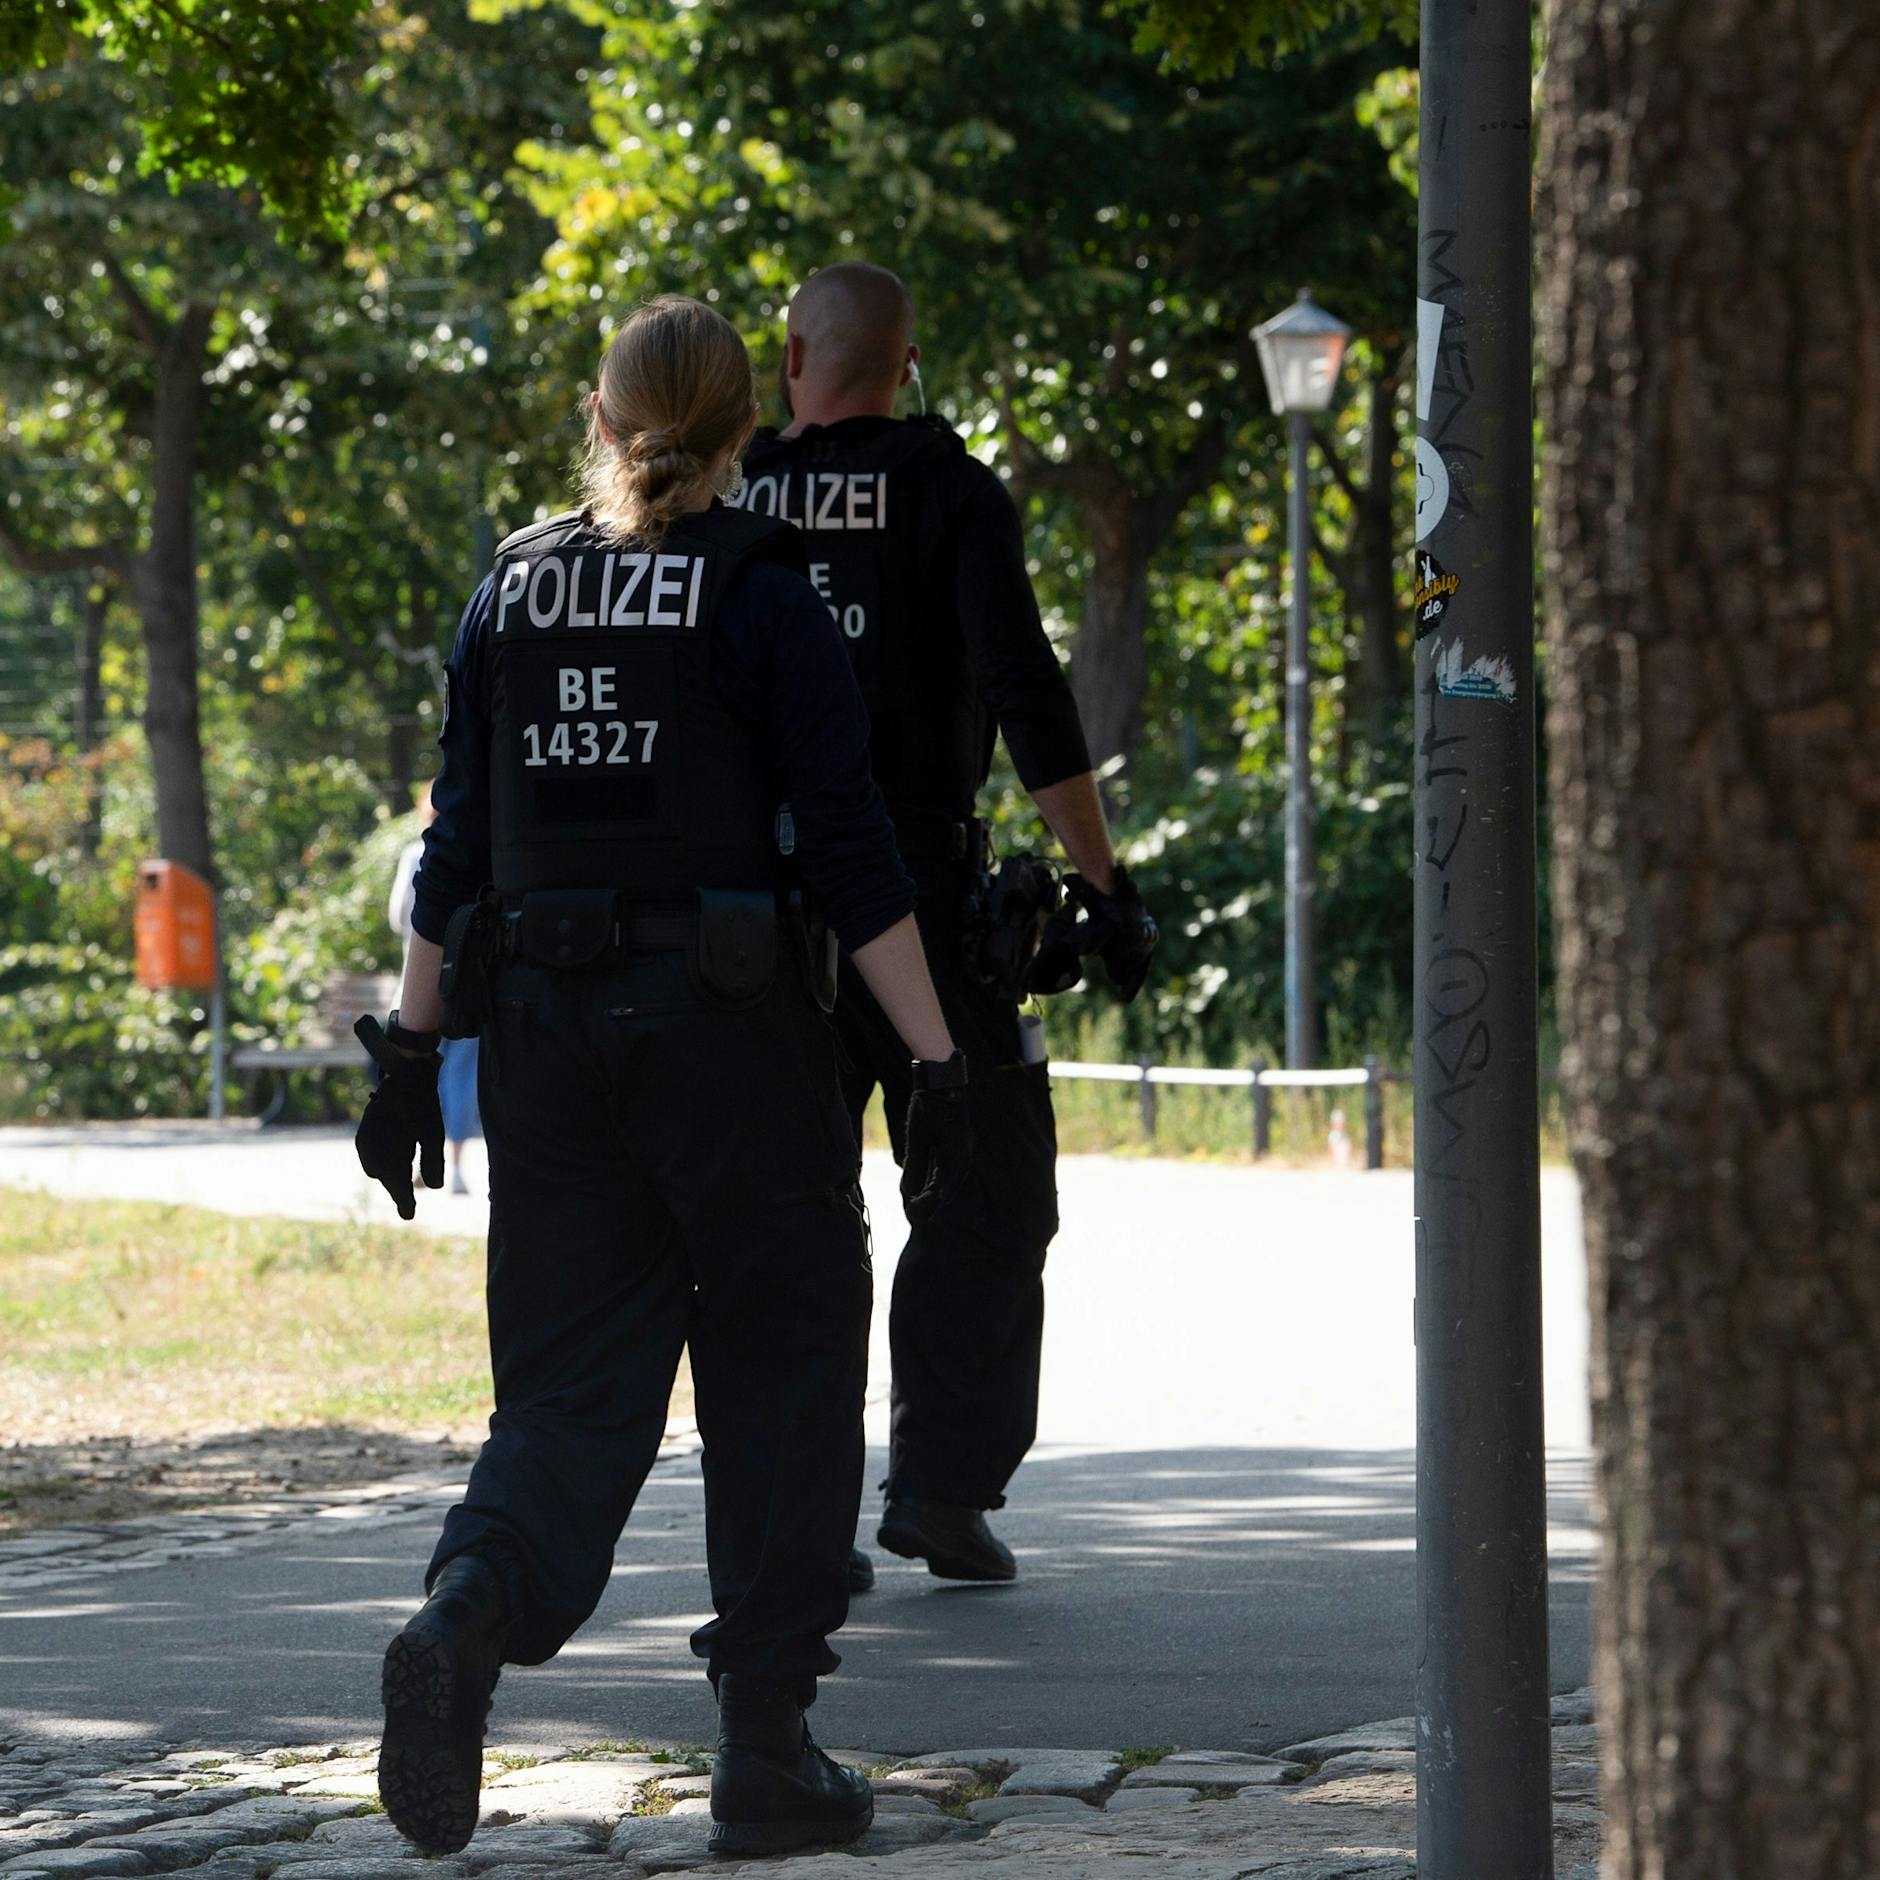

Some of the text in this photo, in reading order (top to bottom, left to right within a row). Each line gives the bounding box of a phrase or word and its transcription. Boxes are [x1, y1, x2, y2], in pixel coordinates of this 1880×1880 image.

[496, 553, 705, 633] POLIZEI
[808, 562, 833, 598] E
[558, 667, 618, 712] BE
[523, 720, 658, 766] 14327
